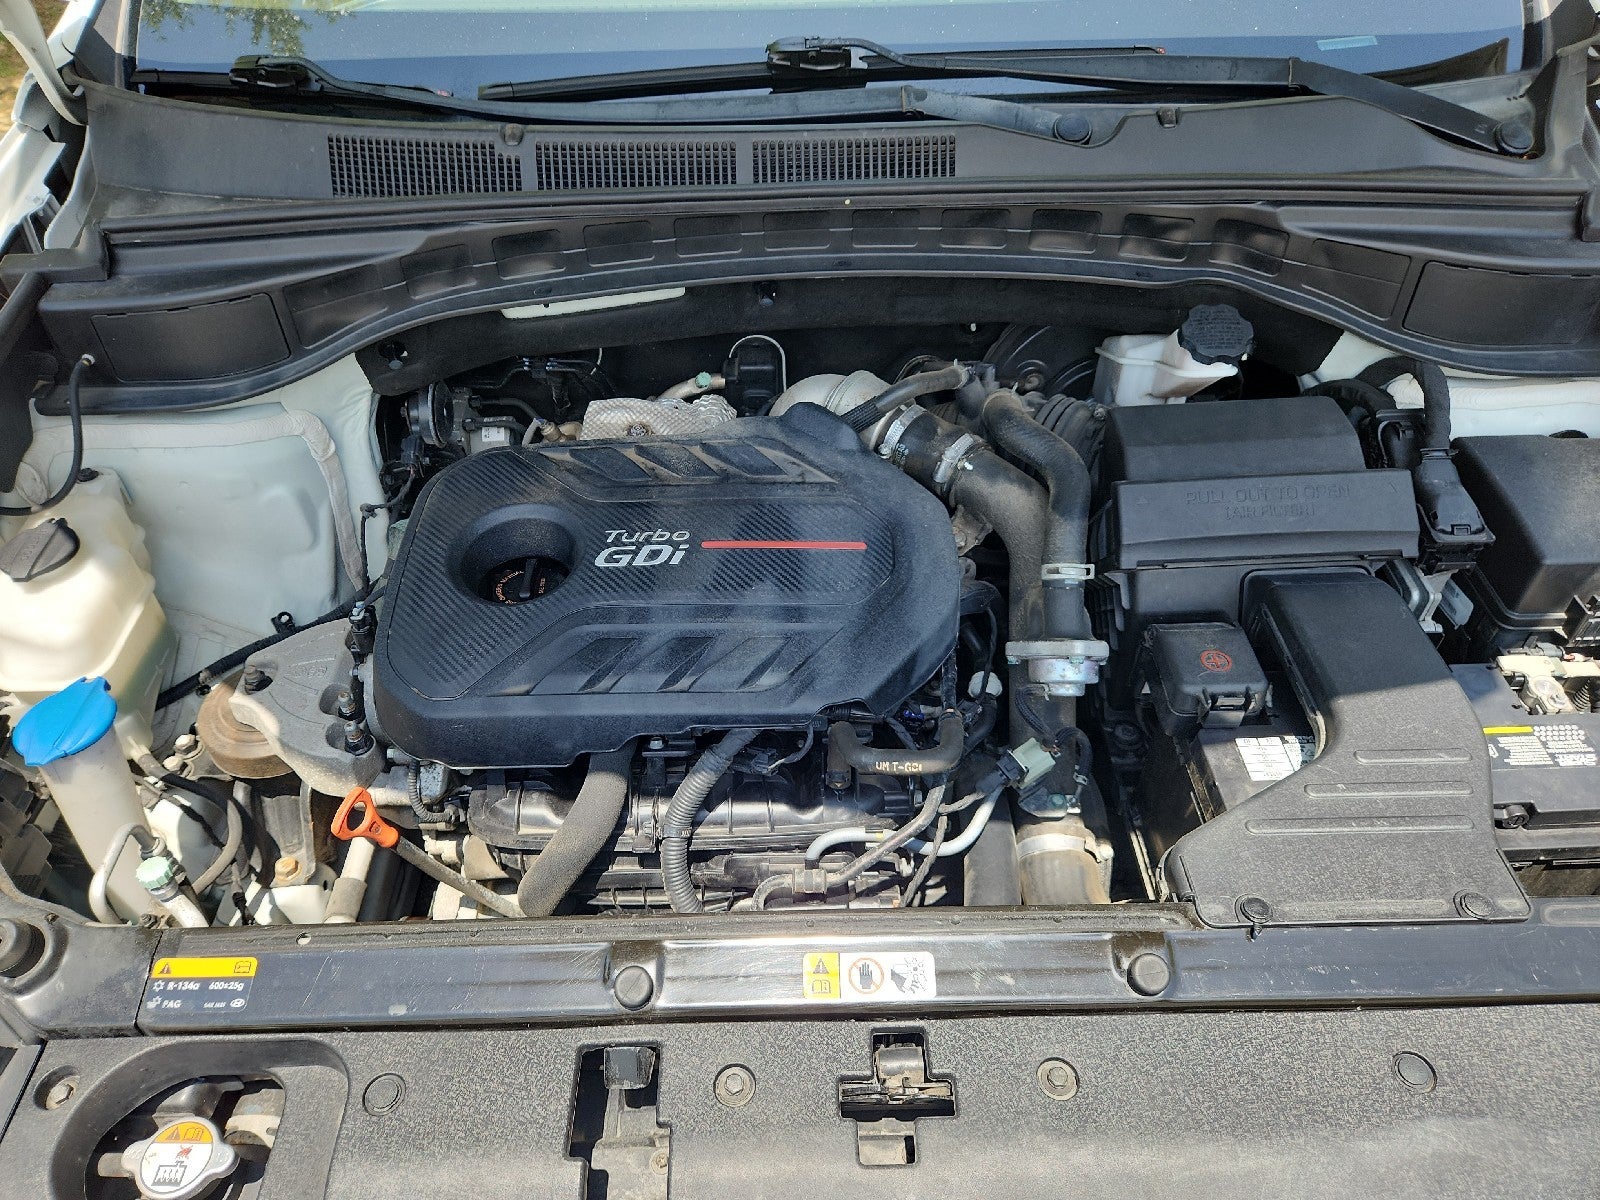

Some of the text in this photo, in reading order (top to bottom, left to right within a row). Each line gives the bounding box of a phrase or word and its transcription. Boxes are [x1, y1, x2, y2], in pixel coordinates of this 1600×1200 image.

[1186, 484, 1351, 504] PULL OUT TO OPEN
[605, 529, 690, 542] Turbo
[595, 544, 689, 567] GDi
[875, 761, 890, 771] UM
[167, 981, 200, 991] R-134a
[162, 1000, 182, 1009] PAG
